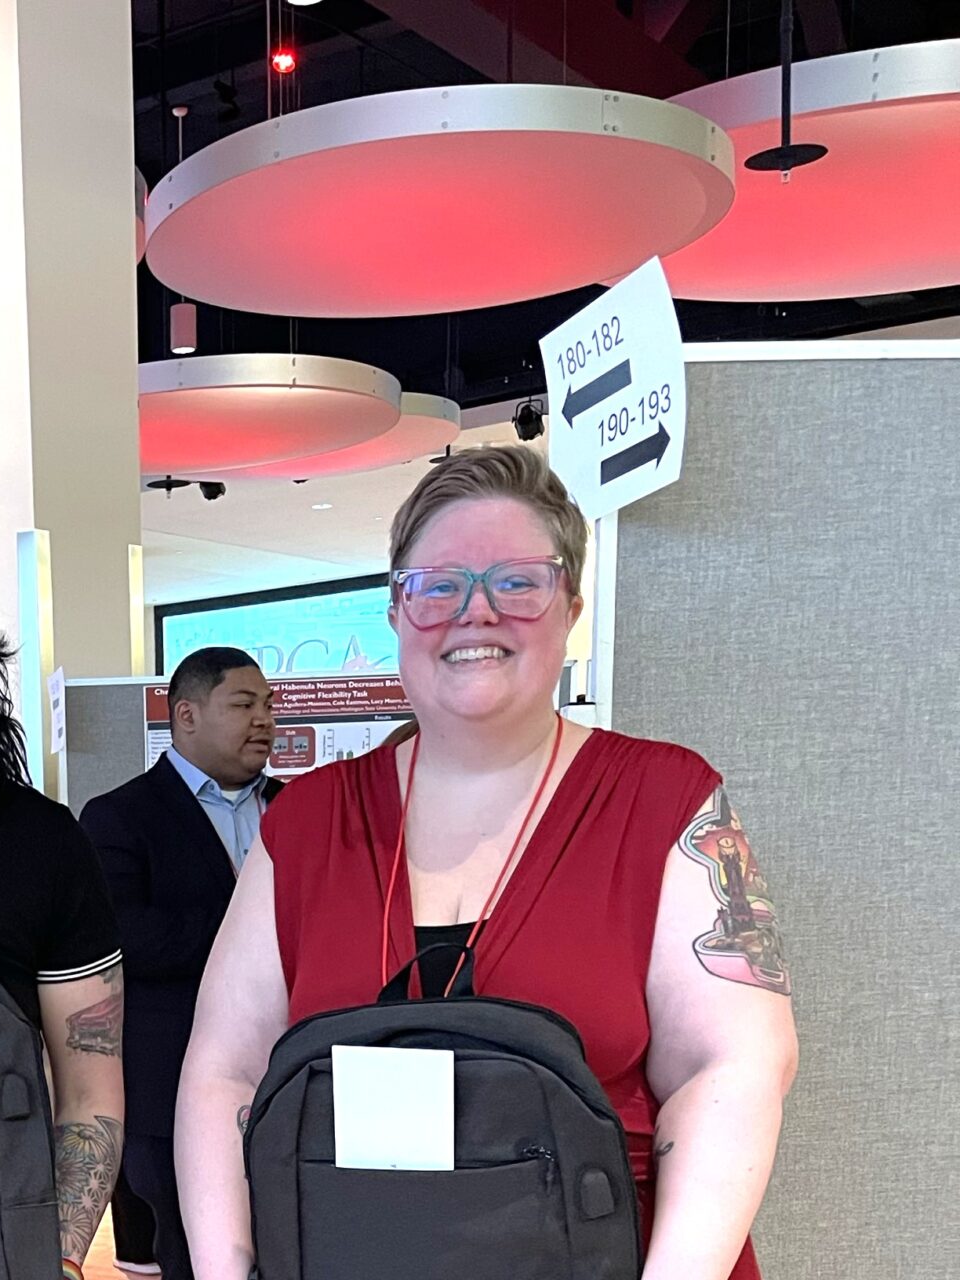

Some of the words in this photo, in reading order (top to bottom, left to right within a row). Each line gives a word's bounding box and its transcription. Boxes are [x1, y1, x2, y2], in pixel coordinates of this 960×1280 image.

[556, 316, 624, 380] 180-182
[597, 383, 672, 447] 190-193
[281, 682, 316, 691] Habenula
[316, 681, 347, 689] Neurons
[348, 680, 384, 688] Decreases
[281, 692, 316, 701] Cognitive
[317, 690, 352, 700] Flexibility
[352, 690, 368, 698] Task
